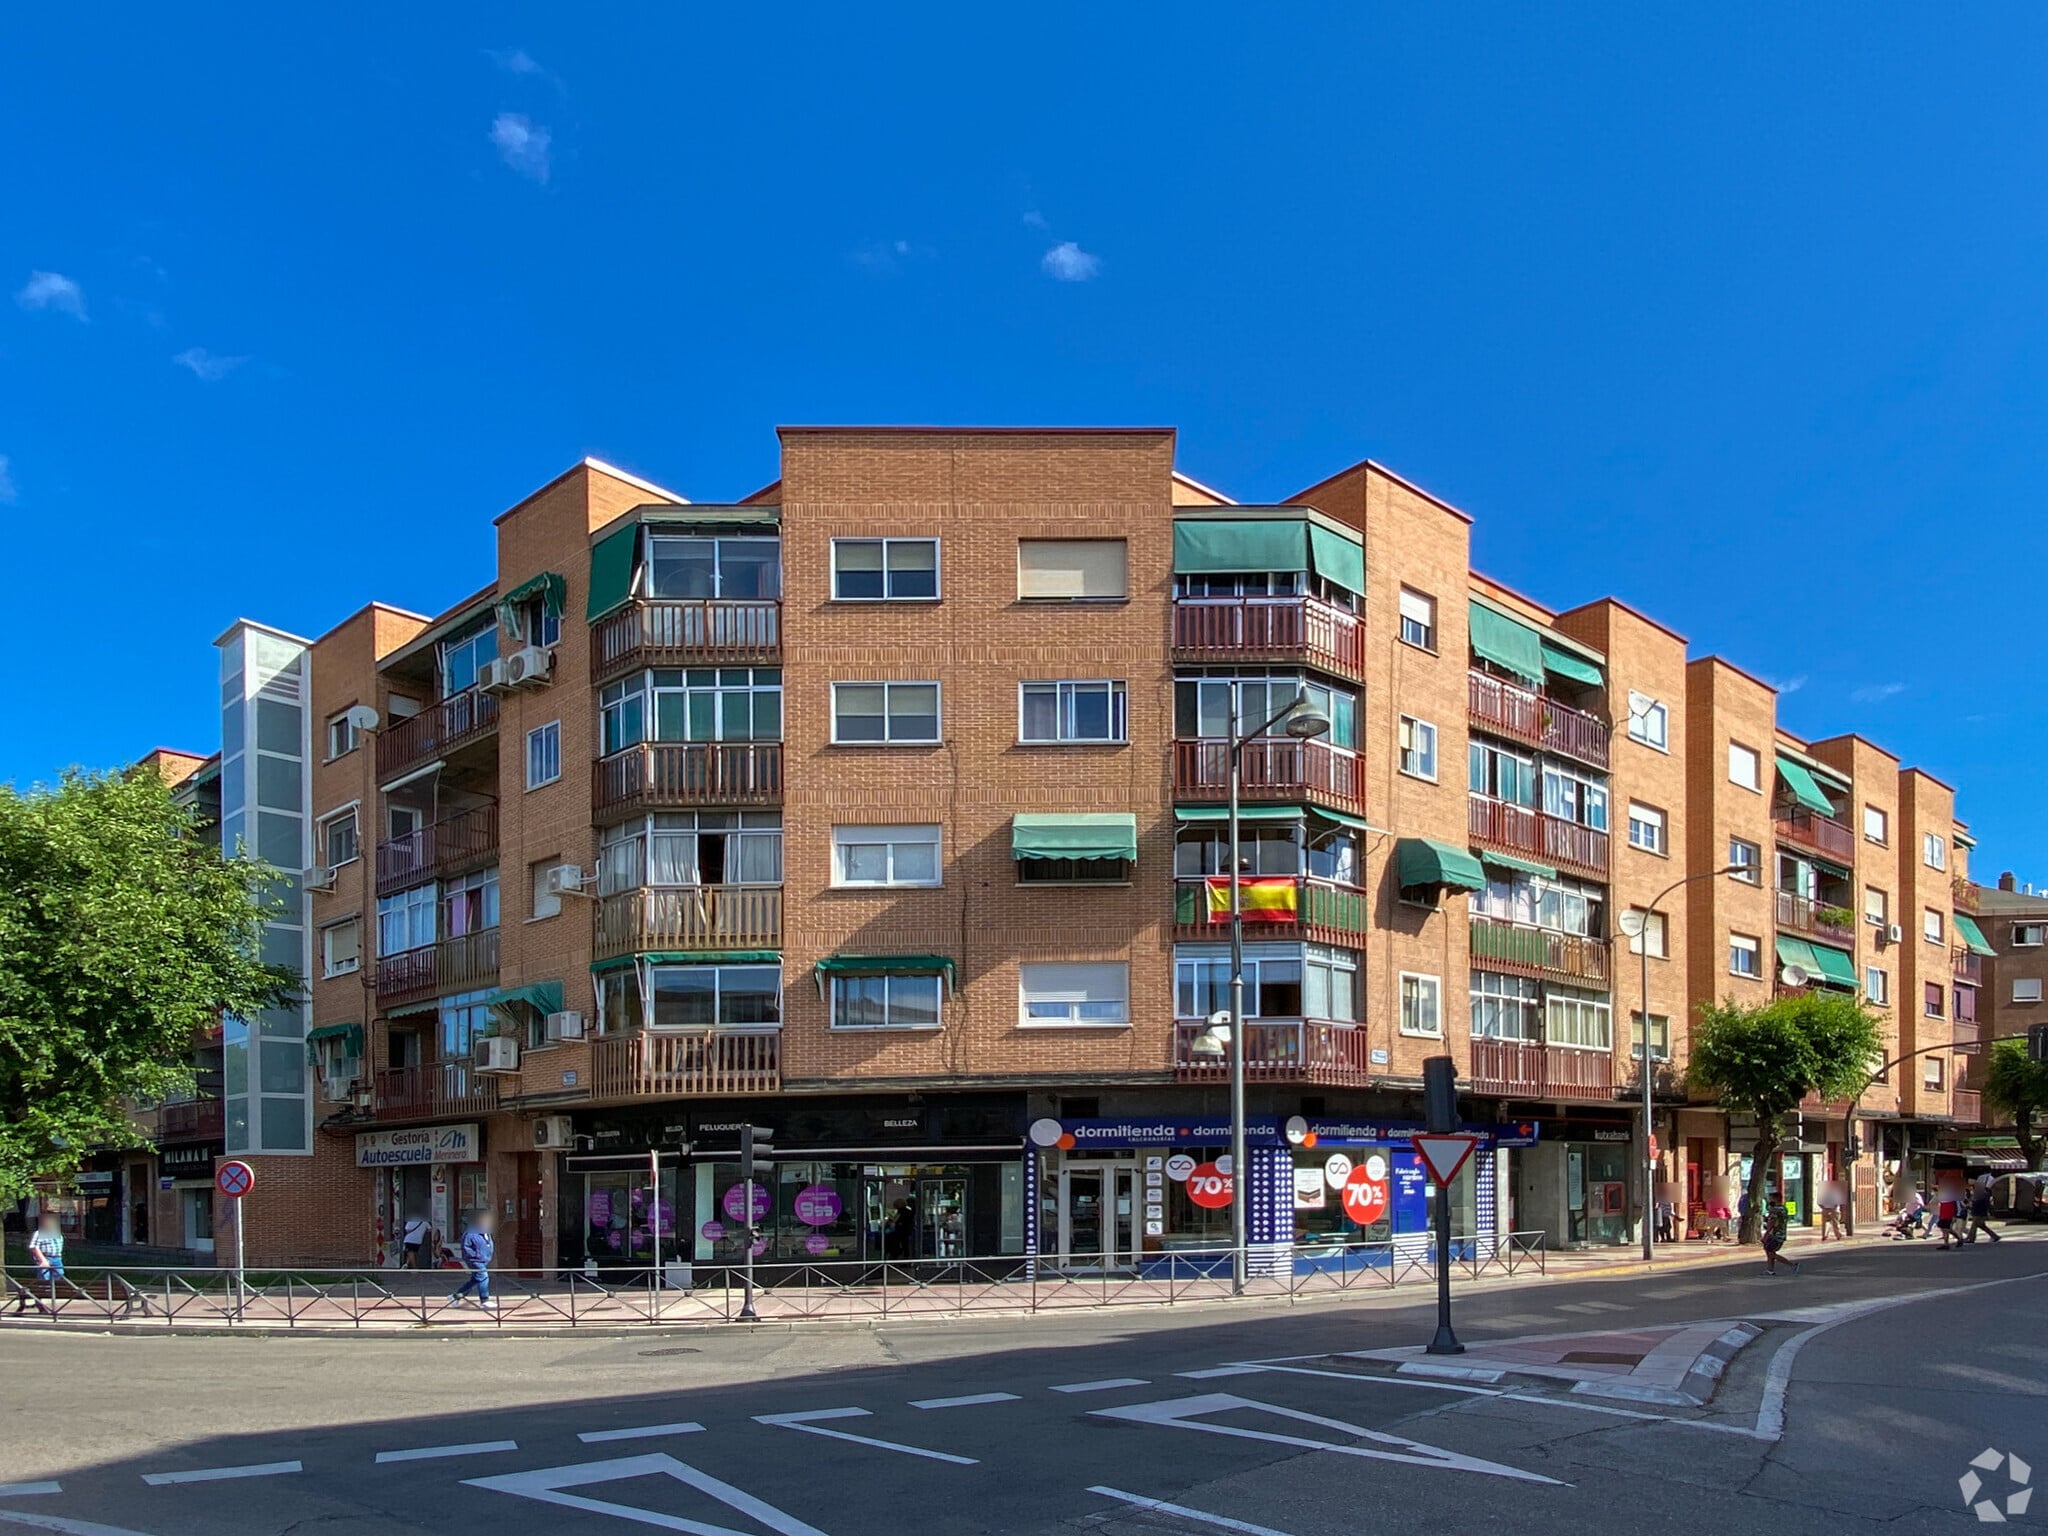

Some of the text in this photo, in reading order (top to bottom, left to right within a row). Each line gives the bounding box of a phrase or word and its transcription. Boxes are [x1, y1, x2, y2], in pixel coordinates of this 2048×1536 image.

[699, 1122, 744, 1131] PELUQUER
[884, 1119, 918, 1127] BELLEZA
[1074, 1125, 1175, 1138] dormitienda
[1193, 1125, 1275, 1136] dormienda
[1312, 1124, 1377, 1137] dormitienda
[391, 1130, 430, 1146] Gestoría
[361, 1145, 433, 1164] Autoescuela
